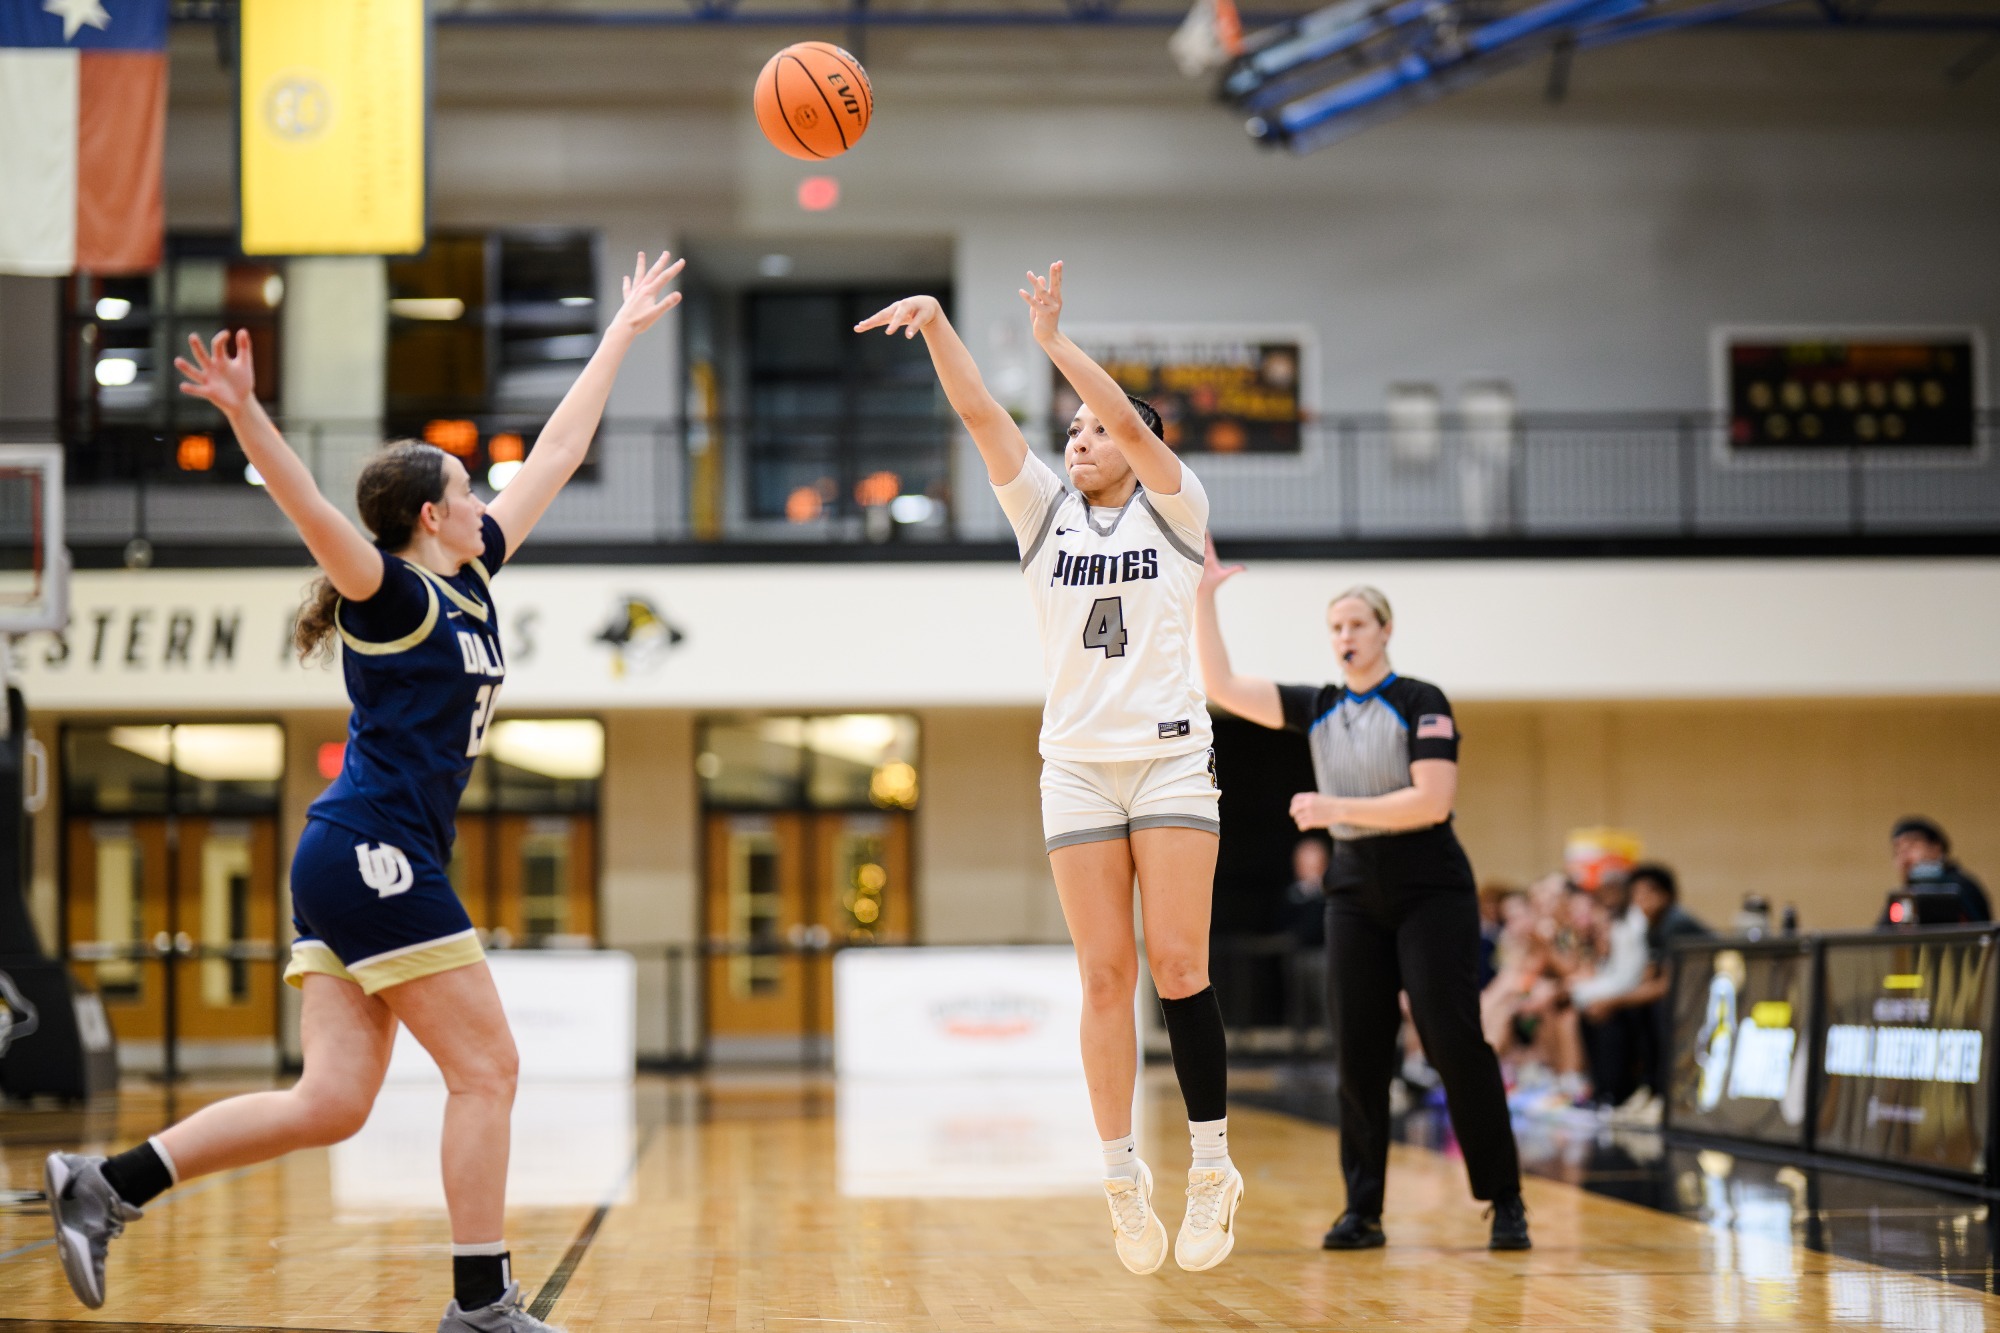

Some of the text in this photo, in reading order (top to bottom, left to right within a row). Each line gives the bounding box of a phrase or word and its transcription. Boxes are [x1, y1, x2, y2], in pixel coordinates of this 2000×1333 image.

[827, 73, 860, 114] EVO
[1050, 547, 1158, 588] PIRATES
[1083, 596, 1127, 659] 4
